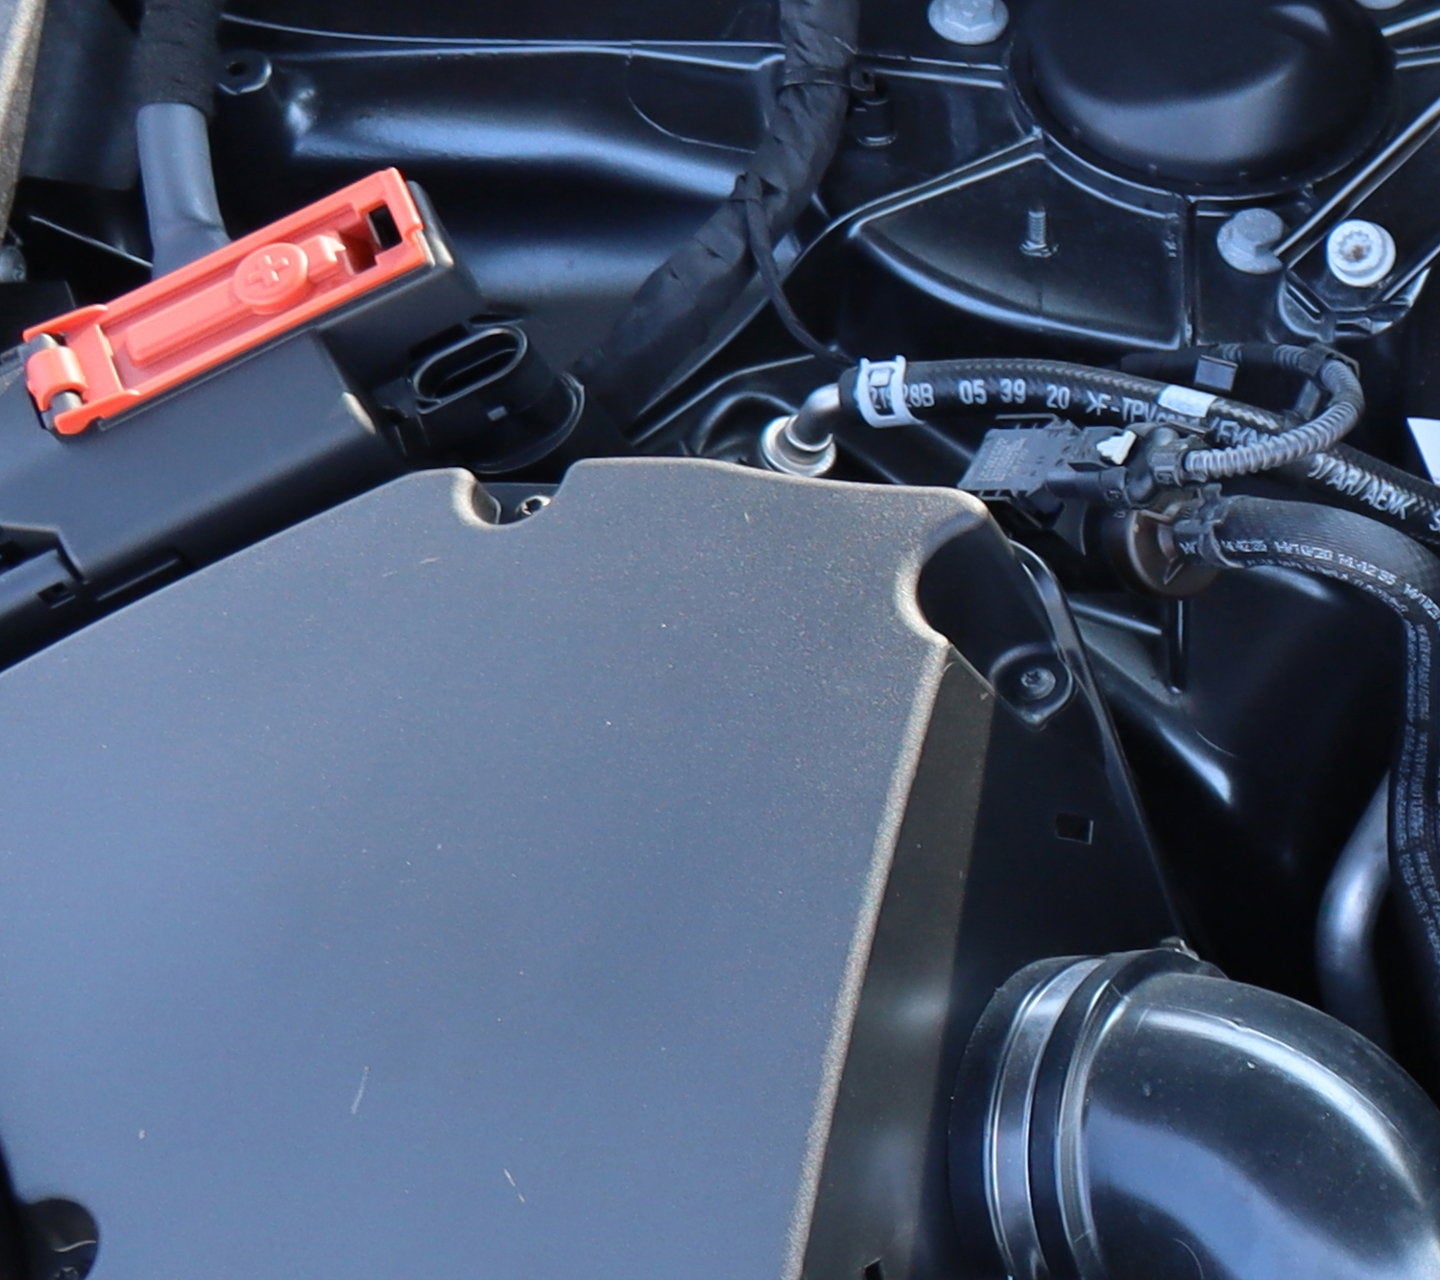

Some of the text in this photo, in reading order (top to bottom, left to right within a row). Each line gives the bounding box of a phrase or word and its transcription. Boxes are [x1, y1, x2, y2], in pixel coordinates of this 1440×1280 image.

[957, 378, 988, 406] 05
[999, 377, 1027, 404] 39
[1046, 383, 1071, 410] 20
